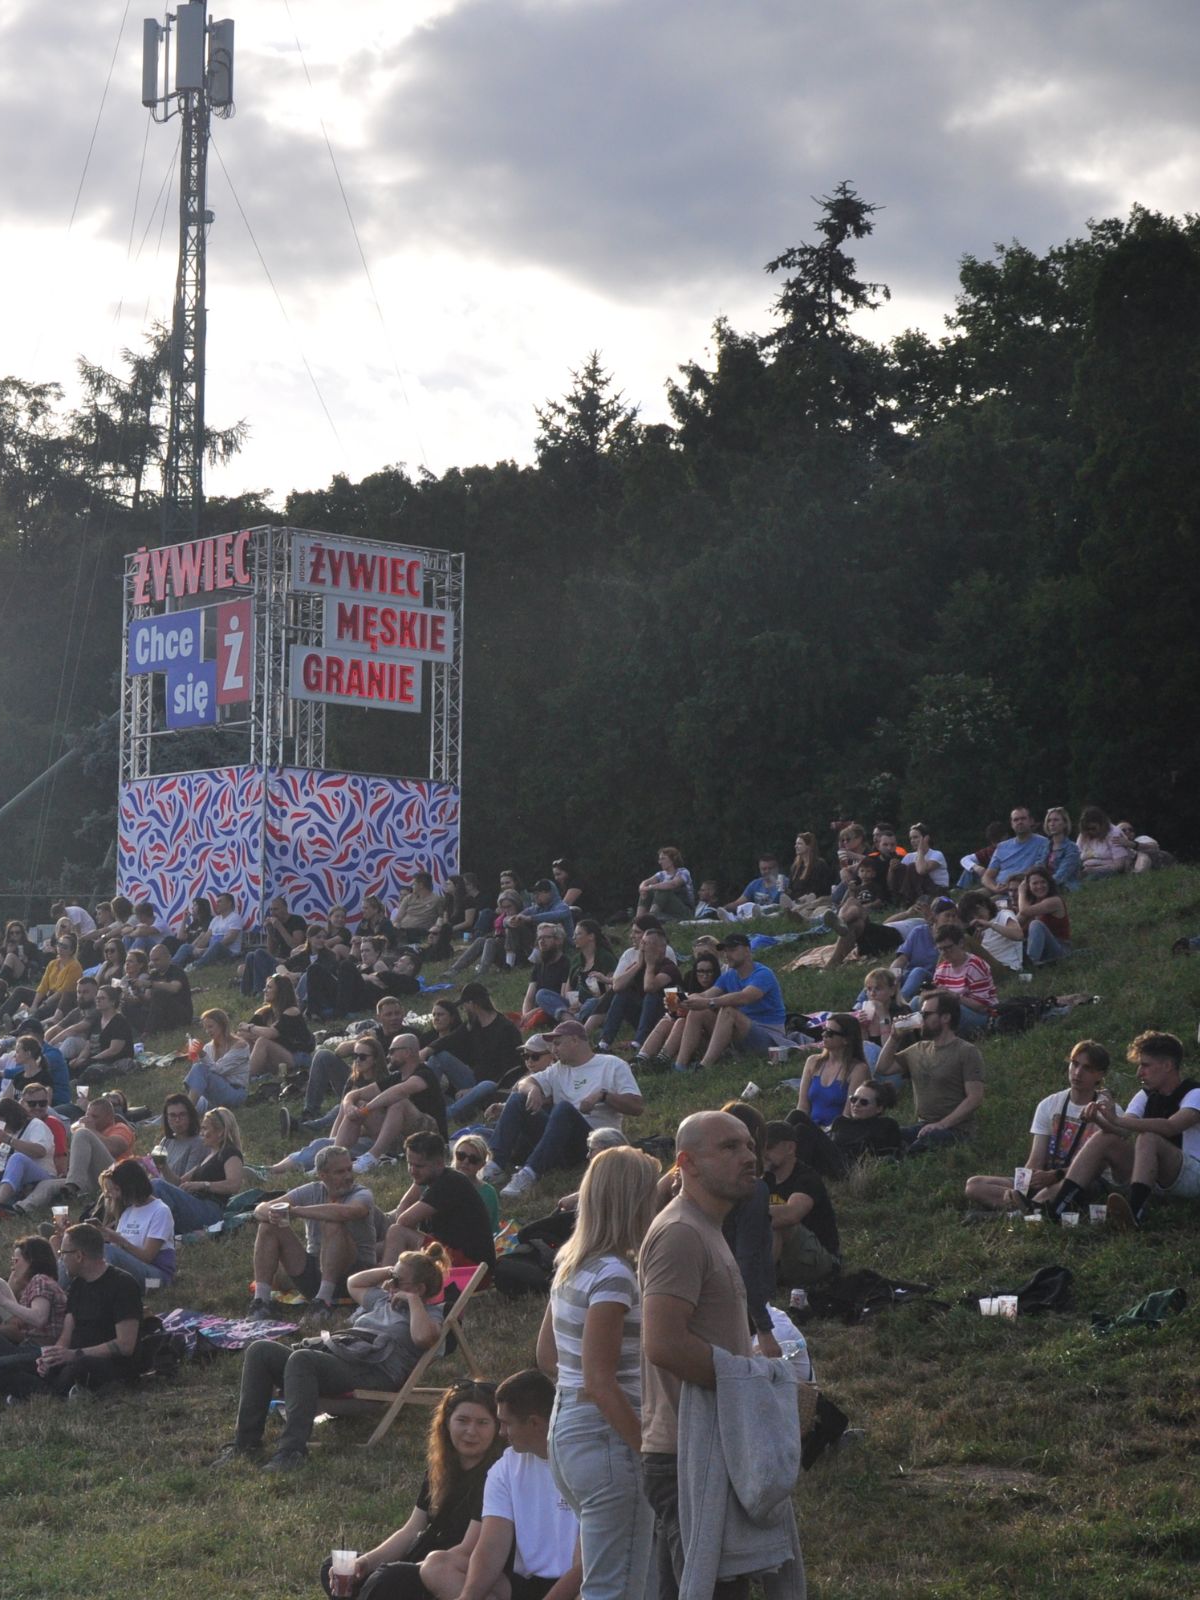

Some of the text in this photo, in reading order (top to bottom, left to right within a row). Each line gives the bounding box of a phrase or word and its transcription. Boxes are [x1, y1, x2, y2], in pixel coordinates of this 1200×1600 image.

[132, 530, 252, 606] ŻYWIEC
[308, 543, 422, 599] ŻYWIEC
[135, 624, 194, 665] Chce
[337, 602, 447, 653] MĘSKIE
[173, 673, 209, 718] się
[302, 653, 415, 705] GRANIE
